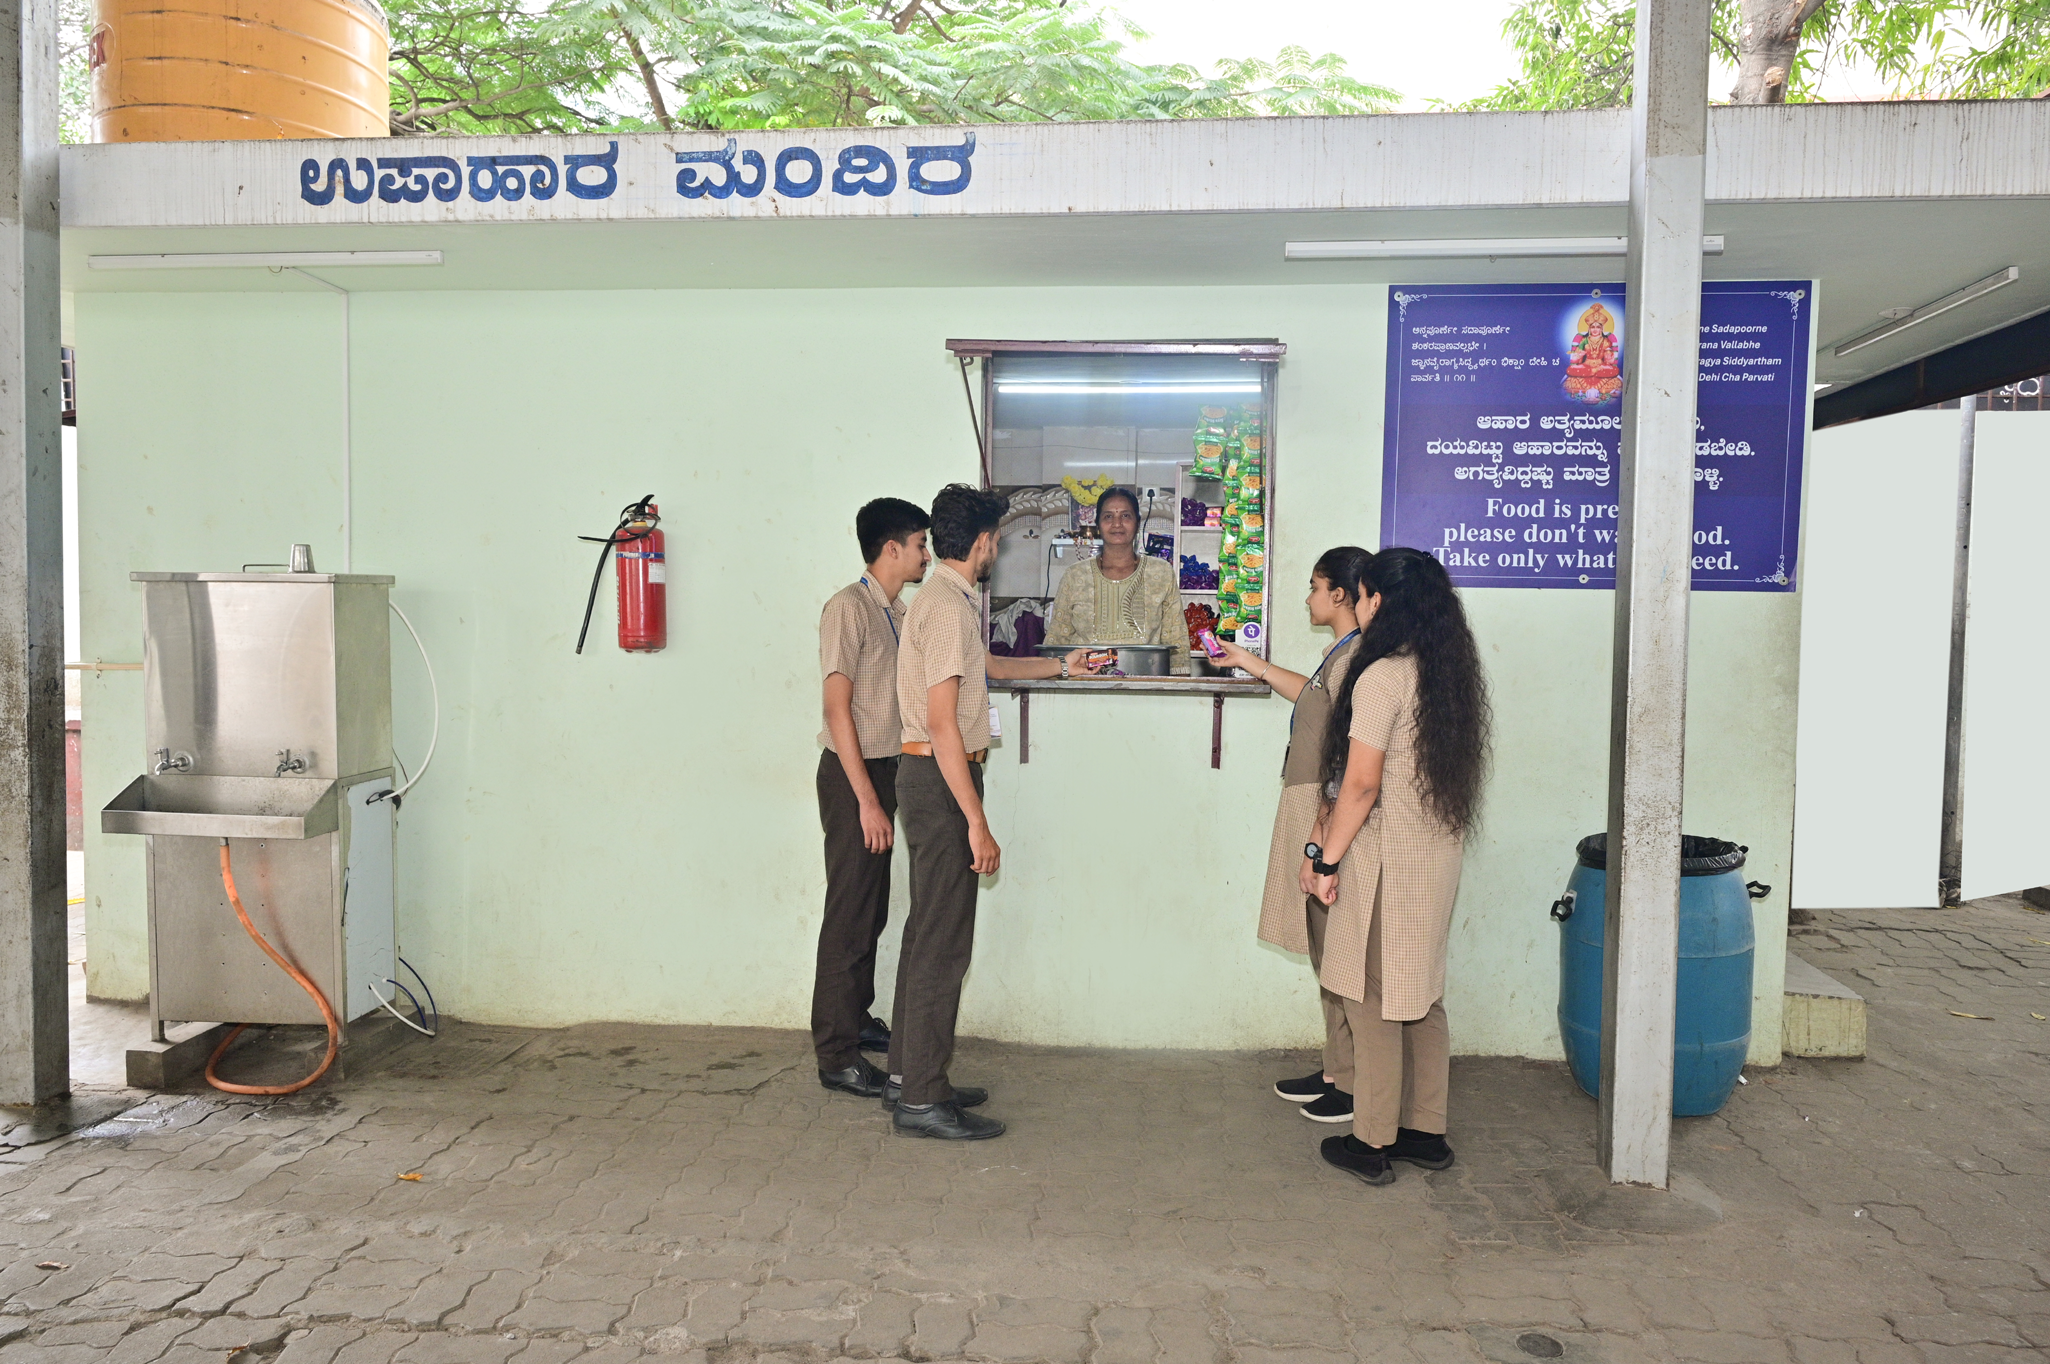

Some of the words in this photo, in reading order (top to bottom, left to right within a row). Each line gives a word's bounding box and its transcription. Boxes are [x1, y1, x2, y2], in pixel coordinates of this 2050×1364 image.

[299, 140, 620, 206] ಉಪಾಹಾರ
[674, 131, 977, 200] ಮಂದಿರ
[1711, 324, 1768, 335] Sadapoorne
[1720, 340, 1761, 349] Vallabhe
[1529, 356, 1548, 366] ದೇಹಿ
[1552, 357, 1560, 366] ಚ
[1722, 356, 1782, 367] Siddyartham
[1699, 372, 1720, 381] Dehi
[1721, 373, 1740, 381] Cha
[1742, 372, 1775, 381] Parvati
[1476, 411, 1531, 429] ಆಹಾರ
[1426, 437, 1504, 463] ದಯವಿಟ್ಟು
[1512, 438, 1608, 462] ಆಹಾರವನ್ನು
[1694, 438, 1755, 456] ಡಬೇಡಿ.
[1454, 463, 1554, 489] ಅಗತ್ಯವಿದ್ದಷ್ಟು
[1563, 463, 1611, 486] ಮಾತ್ರ
[1485, 498, 1545, 518] Food
[1553, 498, 1572, 518] is
[1443, 523, 1516, 547] please
[1523, 523, 1586, 543] don't
[1693, 525, 1730, 545] od.
[1433, 547, 1490, 567] Take
[1497, 548, 1549, 573] only
[1556, 549, 1616, 568] what
[1691, 551, 1739, 570] eed.
